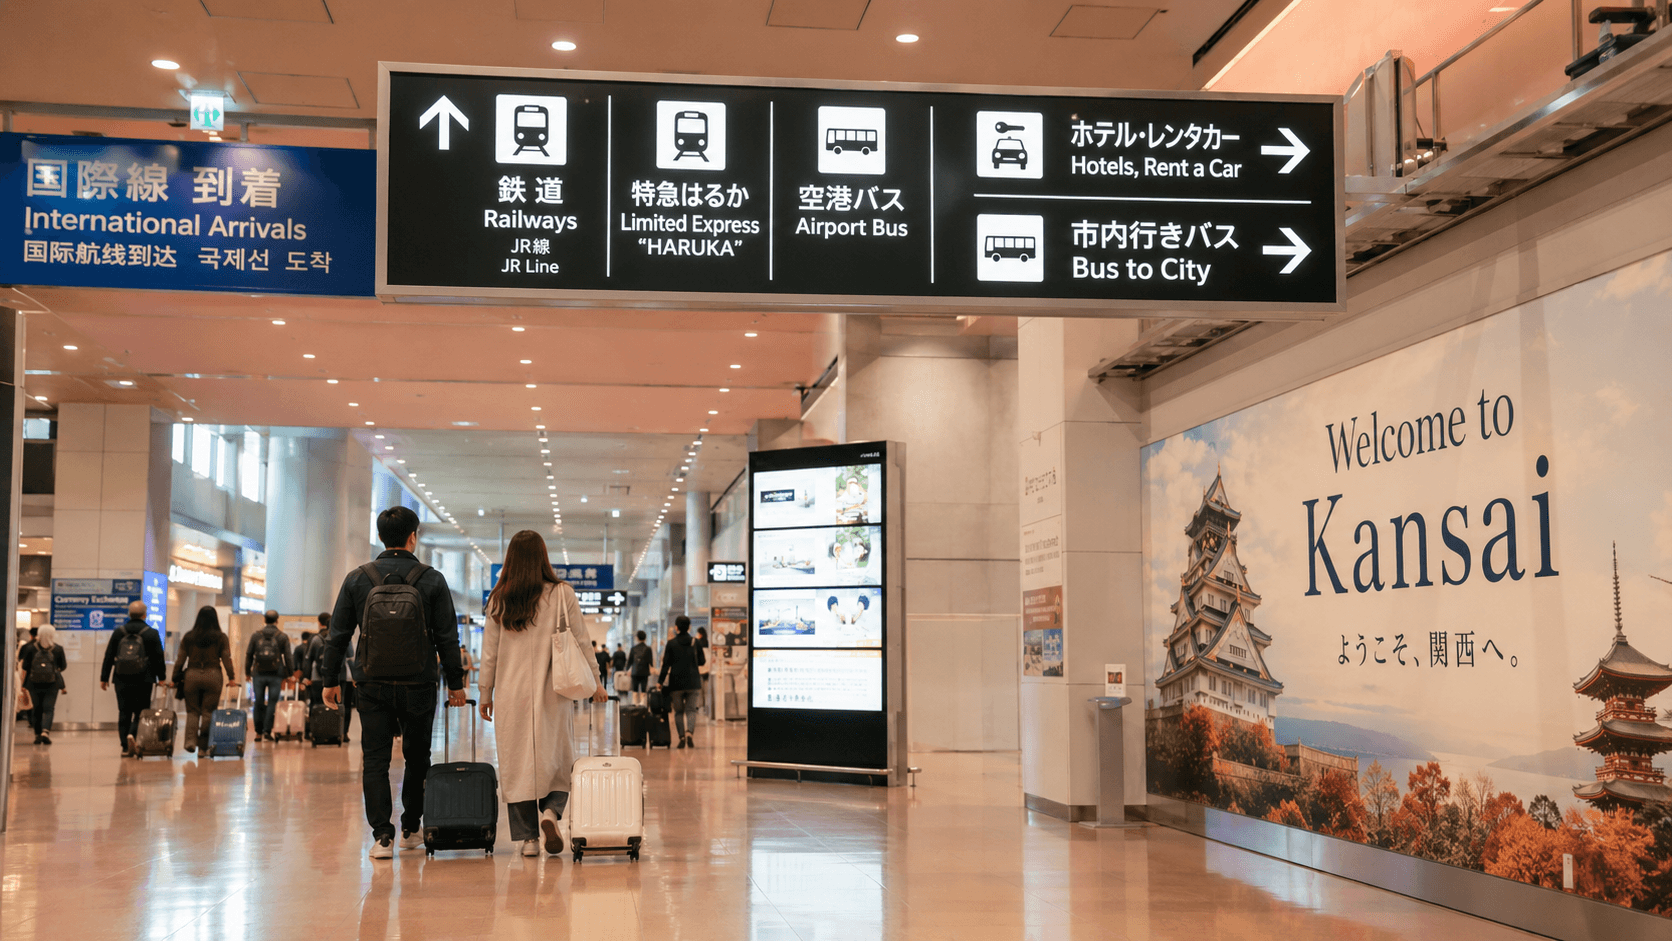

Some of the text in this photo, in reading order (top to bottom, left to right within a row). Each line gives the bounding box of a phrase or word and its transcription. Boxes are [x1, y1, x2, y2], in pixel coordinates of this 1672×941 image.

[1070, 119, 1240, 150] ホテル・レンタカー
[1071, 155, 1242, 179] Hotels, Rent a Car
[26, 157, 282, 208] 国際線 到着
[498, 175, 564, 205] 鉄道
[631, 179, 750, 208] 特急はるか
[798, 184, 905, 212] 空港バス
[25, 207, 307, 241] International Arrivals
[484, 209, 578, 233] Railways
[621, 212, 760, 237] Limited Express
[795, 216, 908, 240] Airport Bus
[1070, 219, 1240, 250] 市内行きバス
[23, 240, 178, 268] 国际航线到达
[197, 247, 333, 274] 국제선 도착
[510, 238, 551, 255] JR線
[638, 238, 743, 257] “HARUKA”
[501, 258, 560, 274] JR Line
[1072, 256, 1212, 287] Bus to City
[1325, 389, 1514, 474] Welcome to
[1302, 454, 1560, 597] Kansai
[1337, 630, 1518, 668] ようこそ、関西へ。
